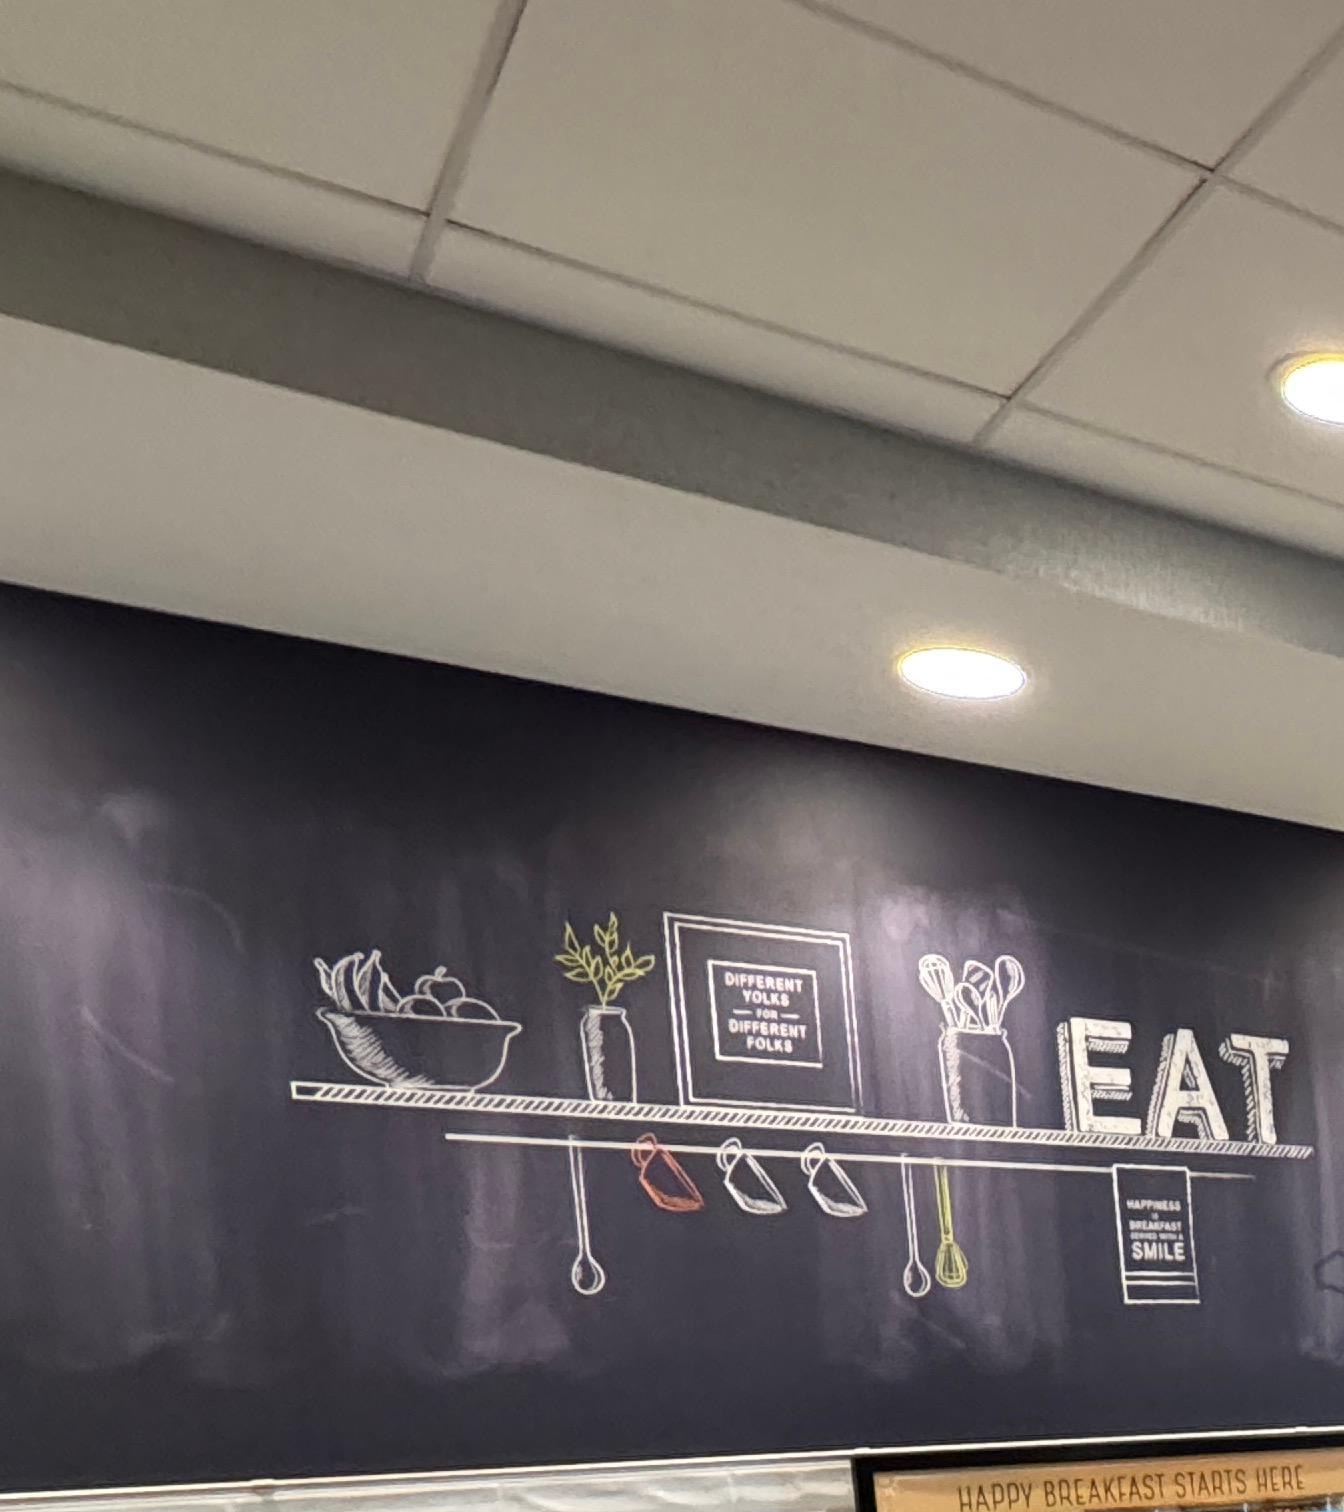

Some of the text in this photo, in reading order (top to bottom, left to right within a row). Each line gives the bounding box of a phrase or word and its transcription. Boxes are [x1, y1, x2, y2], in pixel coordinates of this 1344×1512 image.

[724, 971, 803, 991] DIFFERENT
[742, 988, 790, 1007] YOLKS
[756, 1008, 778, 1020] FOR
[728, 1018, 807, 1039] DIFFERENT
[746, 1035, 793, 1054] FOLKS
[1056, 1016, 1290, 1145] EAT
[1126, 1199, 1181, 1211] HAPPINESS
[1128, 1220, 1182, 1231] BREAKFAST
[1131, 1241, 1185, 1261] SMILE
[957, 1464, 1305, 1512] HAPPY BREAKFAST STARTS HERE
